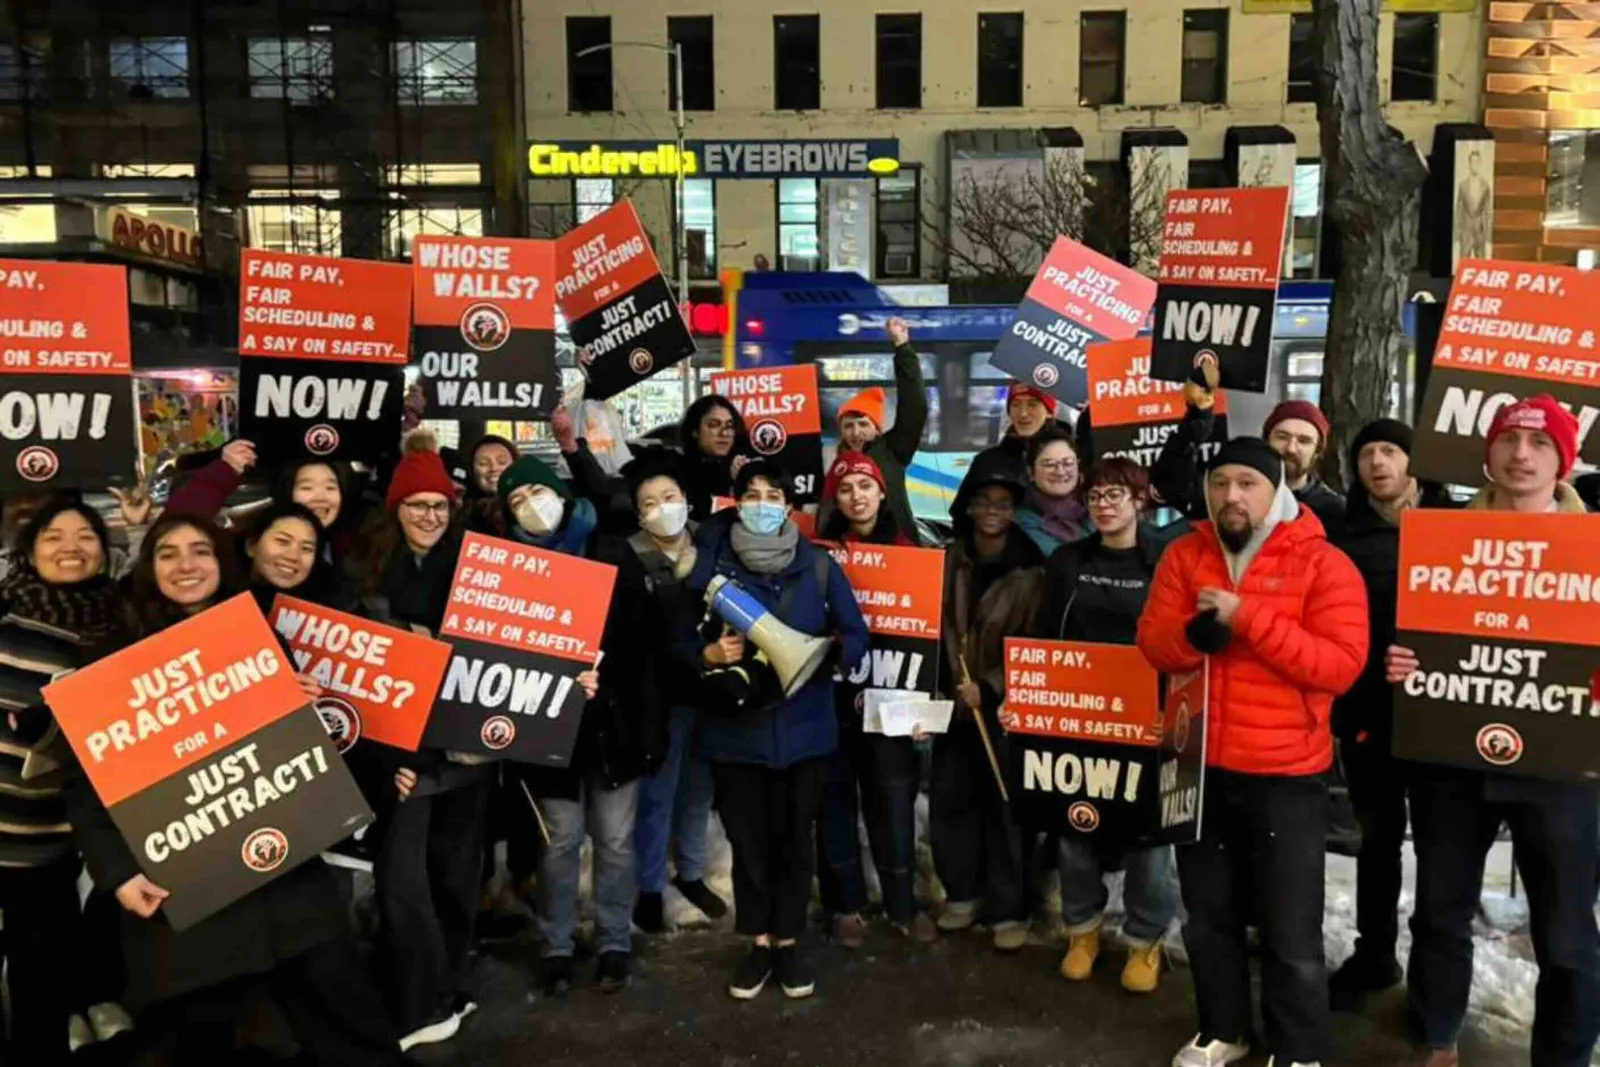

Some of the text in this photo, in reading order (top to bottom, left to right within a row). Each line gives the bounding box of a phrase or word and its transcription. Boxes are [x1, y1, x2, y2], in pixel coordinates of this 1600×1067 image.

[528, 142, 868, 175] Cinderella EYEBROWS
[1167, 197, 1233, 215] FAIR PAY,
[1165, 222, 1196, 237] FAIR
[419, 243, 511, 270] WHOSE
[571, 233, 607, 270] JUST
[1162, 241, 1253, 257] SCHEDULING &
[248, 260, 344, 287] FAIR PAY,
[554, 236, 645, 300] PRACTICING
[1076, 265, 1121, 293] JUST
[1160, 265, 1276, 283] A SAY ON SAFETY...
[1459, 267, 1566, 297] FAIR PAY,
[246, 286, 292, 305] FAIR
[433, 273, 540, 300] WALLS?
[594, 283, 621, 302] FOR A
[1043, 267, 1141, 325] PRACTICING
[601, 296, 638, 331] JUST
[1064, 302, 1094, 323] FOR A
[1451, 294, 1503, 315] FAIR
[71, 321, 87, 339] &
[244, 307, 375, 332] SCHEDULING &
[586, 301, 672, 361] CONTRACT!
[1047, 318, 1093, 348] JUST
[1163, 300, 1261, 348] NOW!
[1444, 316, 1595, 350] SCHEDULING &
[243, 334, 406, 359] A SAY ON SAFETY...
[1012, 320, 1087, 369] CONTRAC
[1438, 343, 1453, 361] A
[1457, 346, 1499, 366] SAY
[1503, 352, 1532, 371] ON
[4, 350, 129, 369] ON SAFETY...
[421, 351, 479, 379] OUR
[1125, 356, 1150, 376] JU
[255, 374, 388, 421] NOW!
[436, 381, 543, 408] WALLS!
[713, 374, 783, 396] WHOSE
[1137, 403, 1173, 416] FOR A
[466, 542, 551, 578] FAIR PAY,
[852, 551, 887, 569] PAY,
[1461, 538, 1548, 569] JUST
[459, 567, 501, 589] FAIR
[452, 587, 573, 626] SCHEDULING &
[900, 594, 912, 608] &
[875, 615, 939, 634] SAFETY...
[1473, 611, 1530, 631] FOR A
[275, 607, 394, 667] WHOSE
[446, 614, 596, 657] A SAY ON SAFETY...
[1009, 646, 1092, 669] FAIR PAY,
[1458, 644, 1546, 678] JUST
[128, 648, 205, 710] JUST
[440, 655, 574, 719] NOW!
[1009, 670, 1047, 688] FAIR
[85, 647, 280, 764] PRACTICING
[1009, 688, 1124, 713] SCHEDULING &
[172, 721, 228, 759] FOR A
[1010, 713, 1157, 741] A SAY ON SAFETY...
[185, 742, 262, 806] JUST
[1023, 749, 1143, 803] NOW!
[143, 744, 329, 863] CONTRACT!
